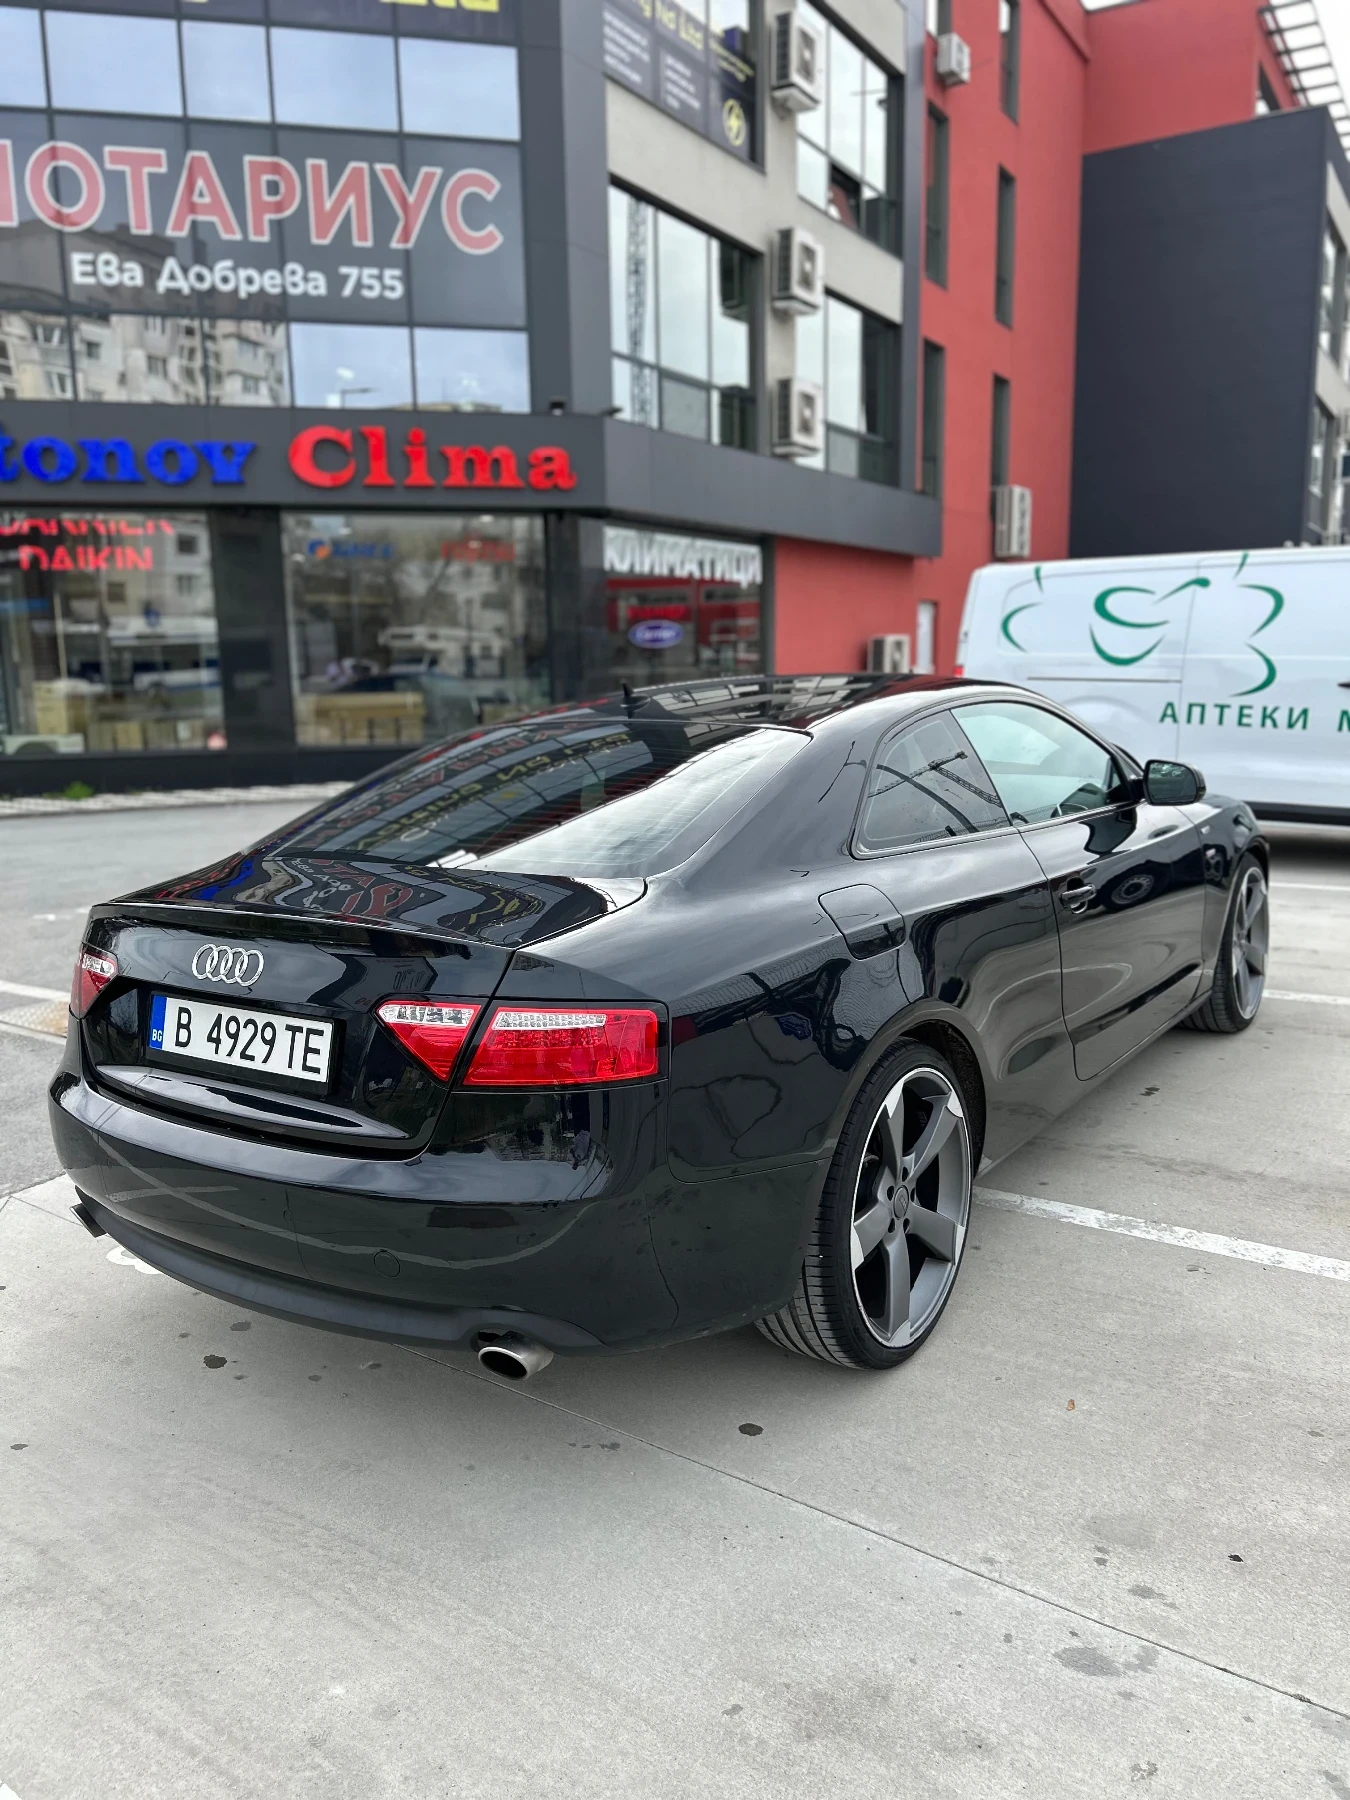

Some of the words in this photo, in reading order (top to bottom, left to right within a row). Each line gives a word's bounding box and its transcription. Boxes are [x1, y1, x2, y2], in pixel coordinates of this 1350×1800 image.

[70, 251, 144, 288] Ева
[156, 257, 328, 299] Добрева
[338, 265, 404, 300] 755
[288, 425, 578, 489] Clima
[1159, 701, 1310, 731] АПТЕКИ
[152, 1028, 163, 1042] BG
[206, 1013, 277, 1064] 4929
[284, 1023, 325, 1075] TE
